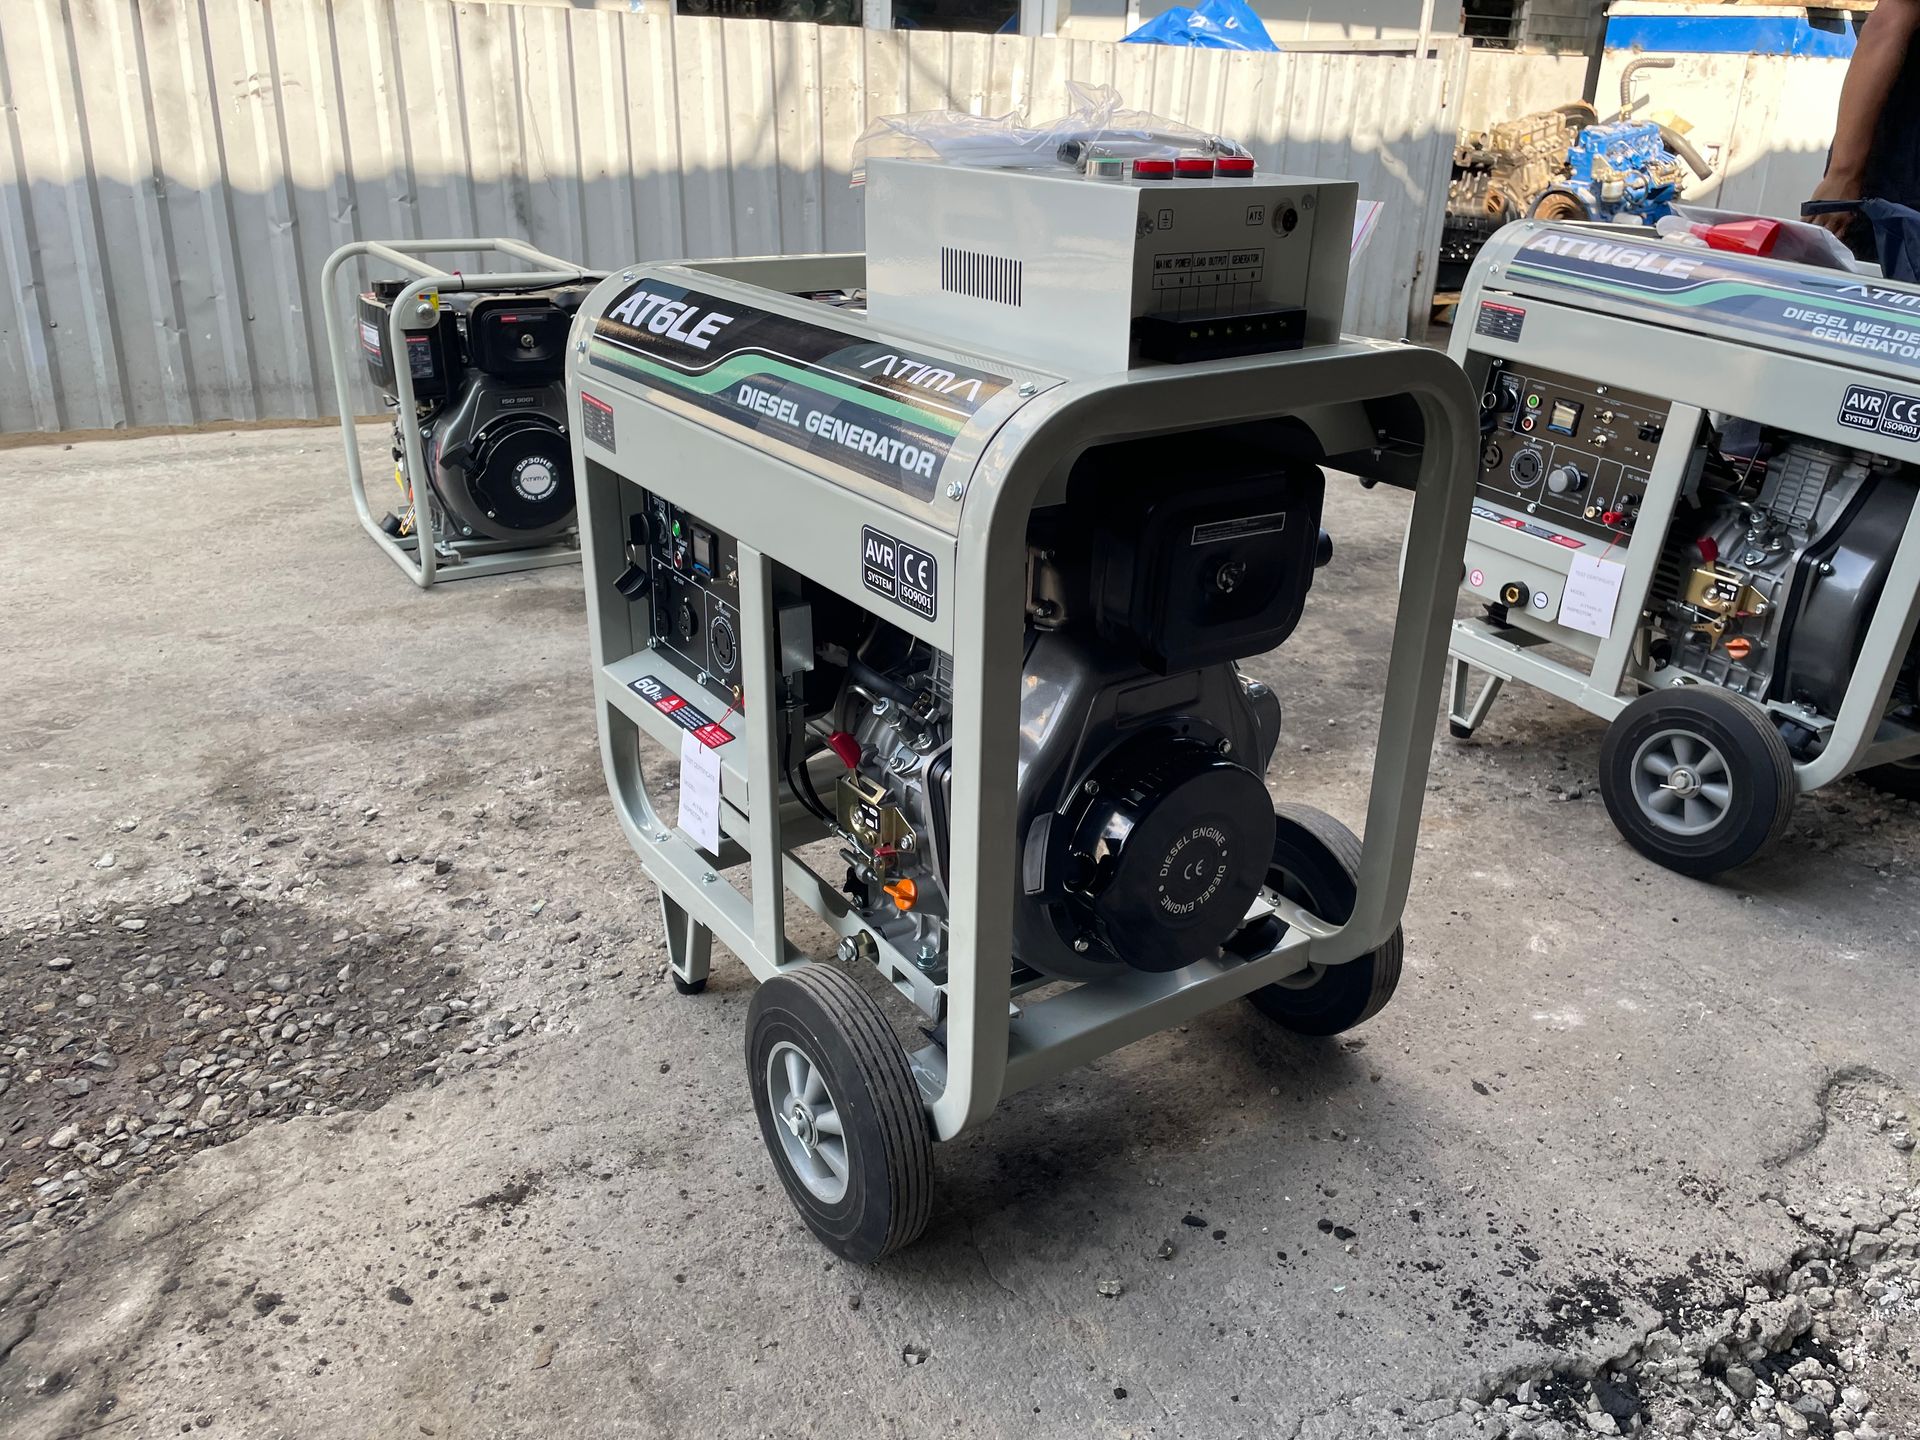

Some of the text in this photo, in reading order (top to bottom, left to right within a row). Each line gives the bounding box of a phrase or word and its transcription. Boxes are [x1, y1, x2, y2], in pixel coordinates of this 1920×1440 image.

[1249, 211, 1263, 221] ATS
[1156, 259, 1173, 269] MAINS
[1194, 257, 1206, 267] LOAD
[1232, 254, 1260, 264] GENERATOR
[1527, 235, 1704, 280] ATW6LE
[1836, 285, 1920, 308] ATIM
[609, 291, 735, 350] AT6LE
[1783, 306, 1920, 345] DIESEL WELDE
[860, 354, 982, 402] ATIMA
[1846, 392, 1882, 413] AVR
[736, 385, 937, 478] DIESEL GENERATOR
[1844, 414, 1874, 426] SYSTEM
[1884, 421, 1918, 435] ISO9001
[515, 480, 557, 501] DIESEL ENGINE
[865, 538, 894, 571] AVR
[867, 571, 893, 592] SYSTEM
[904, 554, 928, 591] CE
[901, 584, 931, 609] ISO9001
[634, 678, 662, 701] 60Hz
[1159, 826, 1226, 877] DIESEL ENGINE
[1160, 864, 1227, 914] DIESEL ENGINE
